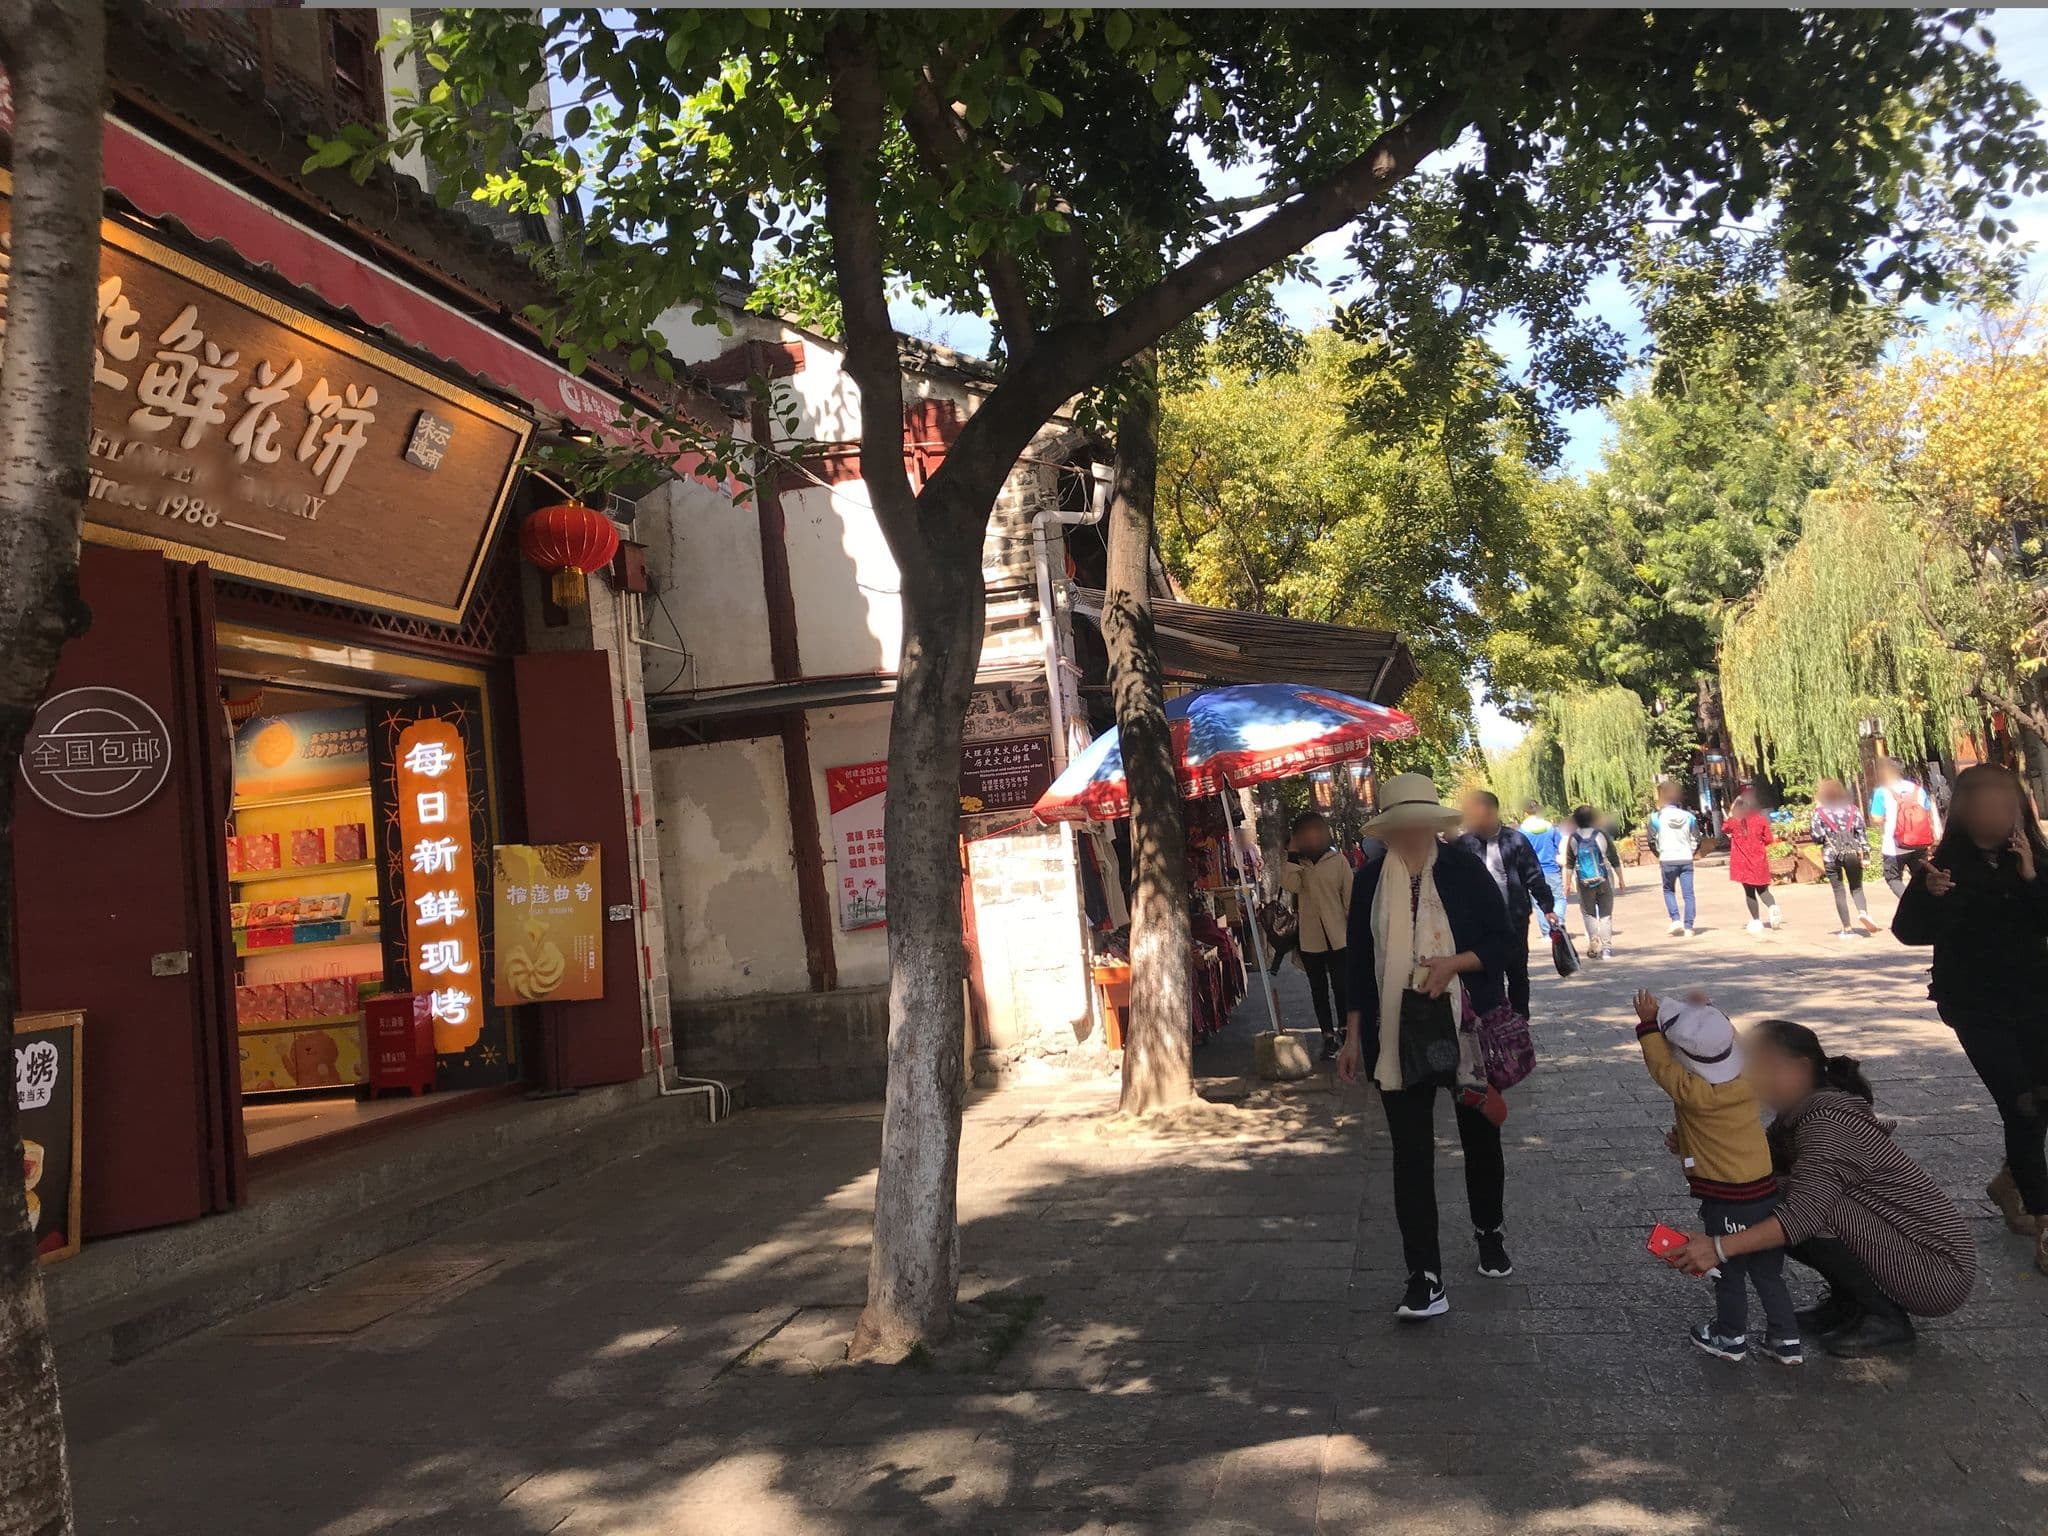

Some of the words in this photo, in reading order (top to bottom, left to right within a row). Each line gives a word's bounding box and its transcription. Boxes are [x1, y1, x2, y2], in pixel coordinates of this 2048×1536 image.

[408, 417, 435, 465] 味道
[426, 425, 451, 469] 云南
[31, 737, 161, 767] 全国包邮
[964, 742, 1041, 758] 大理历史文化名城
[846, 831, 863, 842] 富强
[867, 828, 884, 840] 民主
[848, 844, 865, 856] 自由
[868, 842, 886, 853] 平等
[403, 742, 472, 1024] 每日新鲜现烤
[507, 882, 592, 906] 榴莲曲奇
[17, 1048, 55, 1087] 烤
